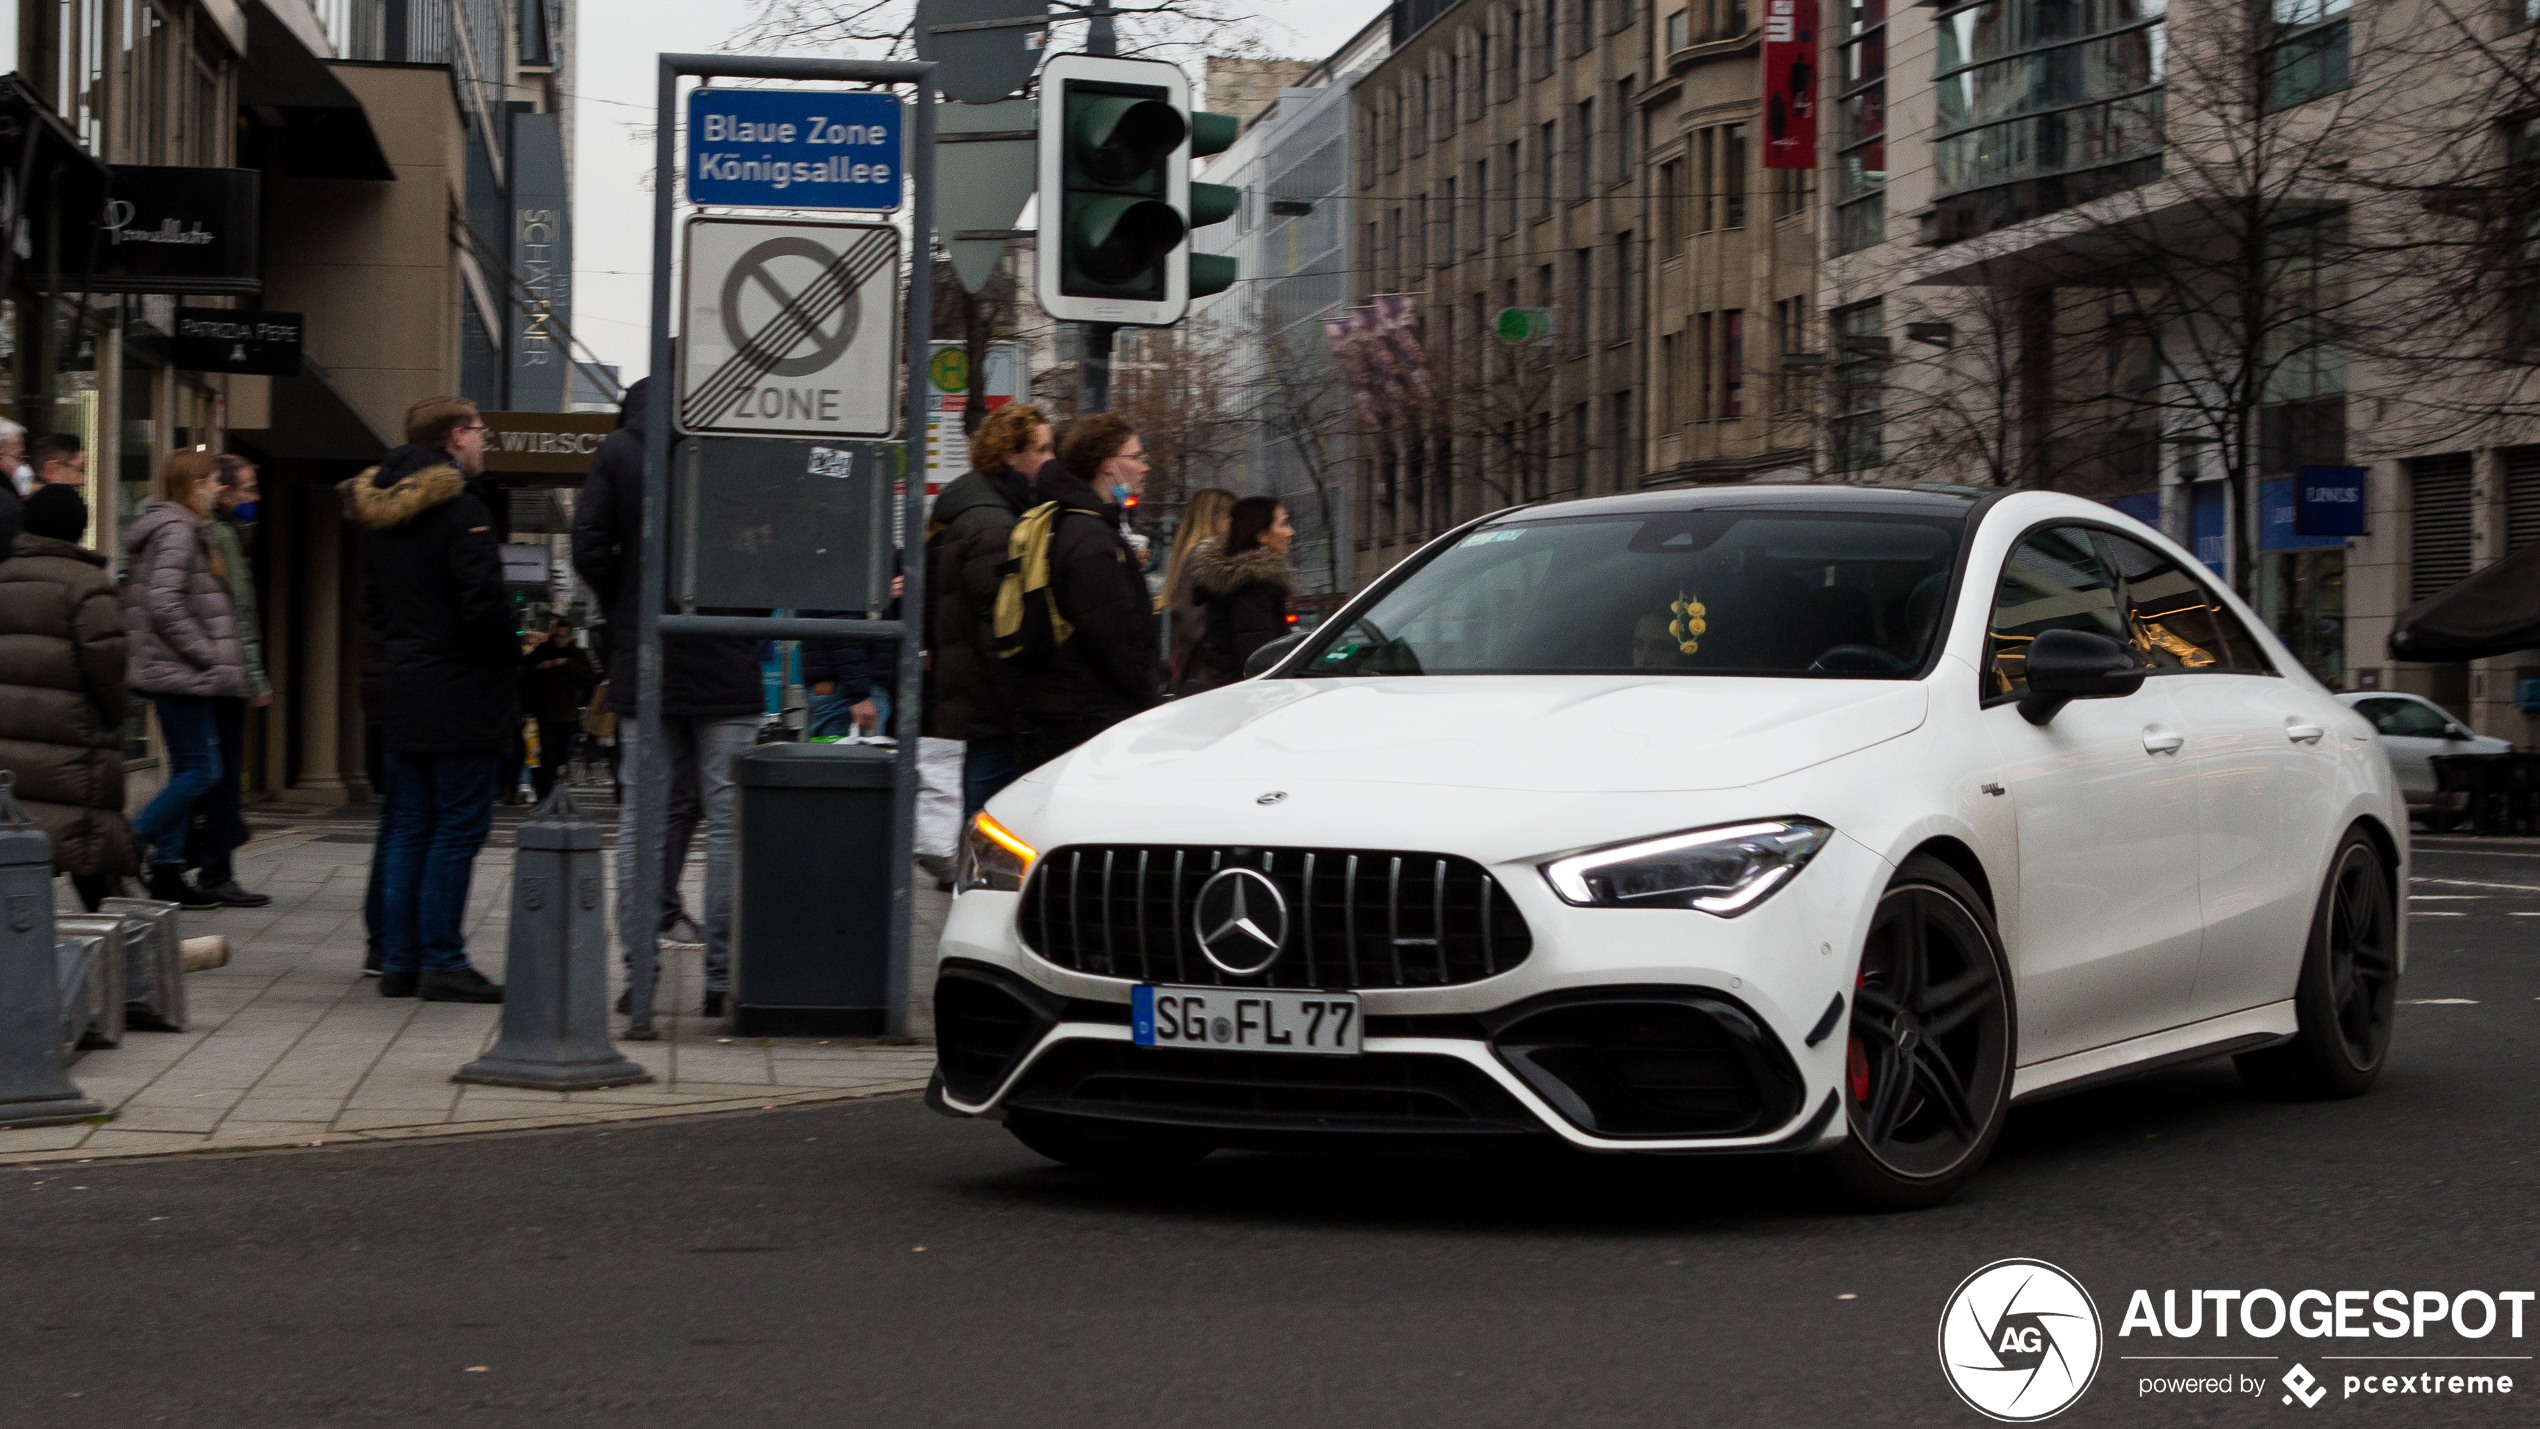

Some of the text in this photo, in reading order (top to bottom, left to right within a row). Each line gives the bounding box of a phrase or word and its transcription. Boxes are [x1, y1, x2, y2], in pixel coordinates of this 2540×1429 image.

[703, 114, 888, 145] Blaue Zone
[698, 152, 891, 189] Königsallee
[255, 322, 299, 342] PEPE
[734, 385, 841, 421] ZONE
[1157, 995, 1207, 1042] SG
[1236, 998, 1292, 1044] FL
[1301, 1000, 1355, 1047] 77
